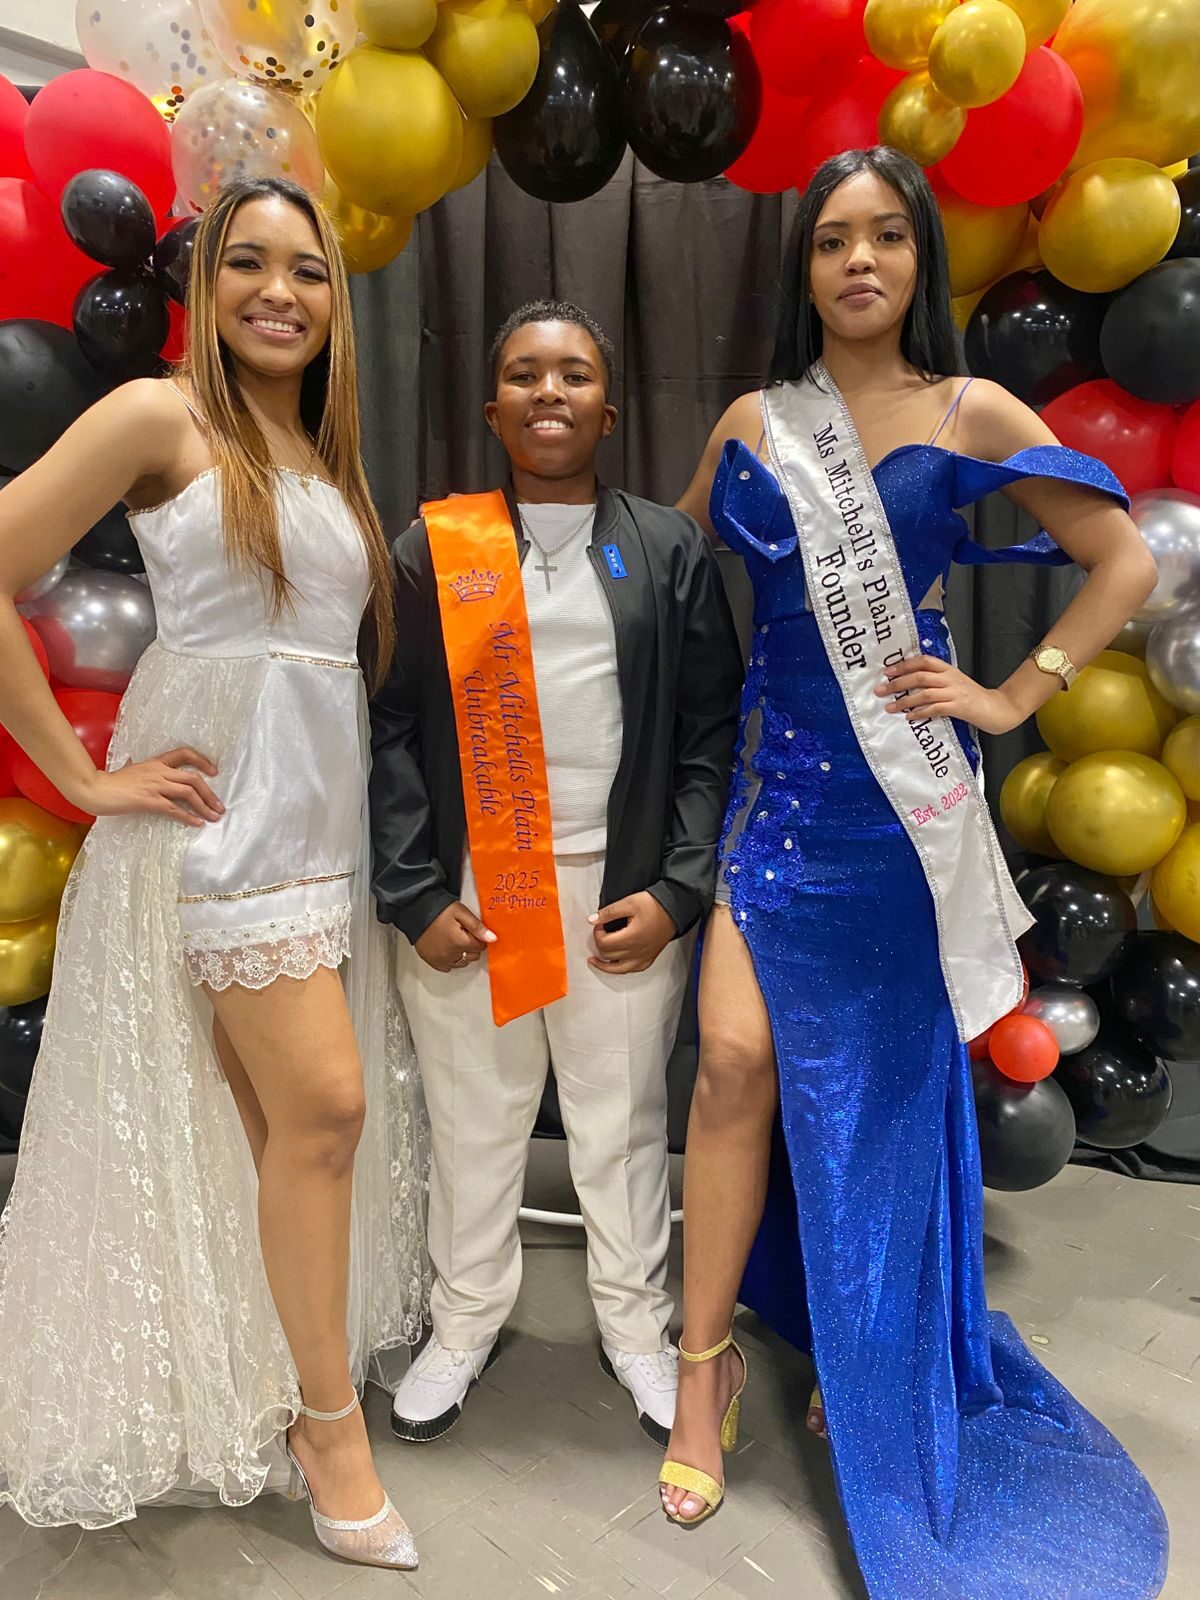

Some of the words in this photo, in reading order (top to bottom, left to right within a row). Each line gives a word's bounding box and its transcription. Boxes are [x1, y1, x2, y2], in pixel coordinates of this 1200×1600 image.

[813, 422, 839, 459] Ms
[825, 459, 878, 572] Mitchell's
[816, 545, 867, 671] Founder
[863, 575, 895, 645] Plain
[489, 621, 520, 664] Mr
[463, 670, 504, 817] Unbreakable
[495, 669, 533, 783] Mitchells
[511, 790, 539, 852] Plain
[911, 806, 940, 826] Est.
[941, 782, 968, 810] 2022
[487, 892, 508, 911] 2nd
[507, 894, 548, 909] Prince
[494, 871, 540, 891] 2025
